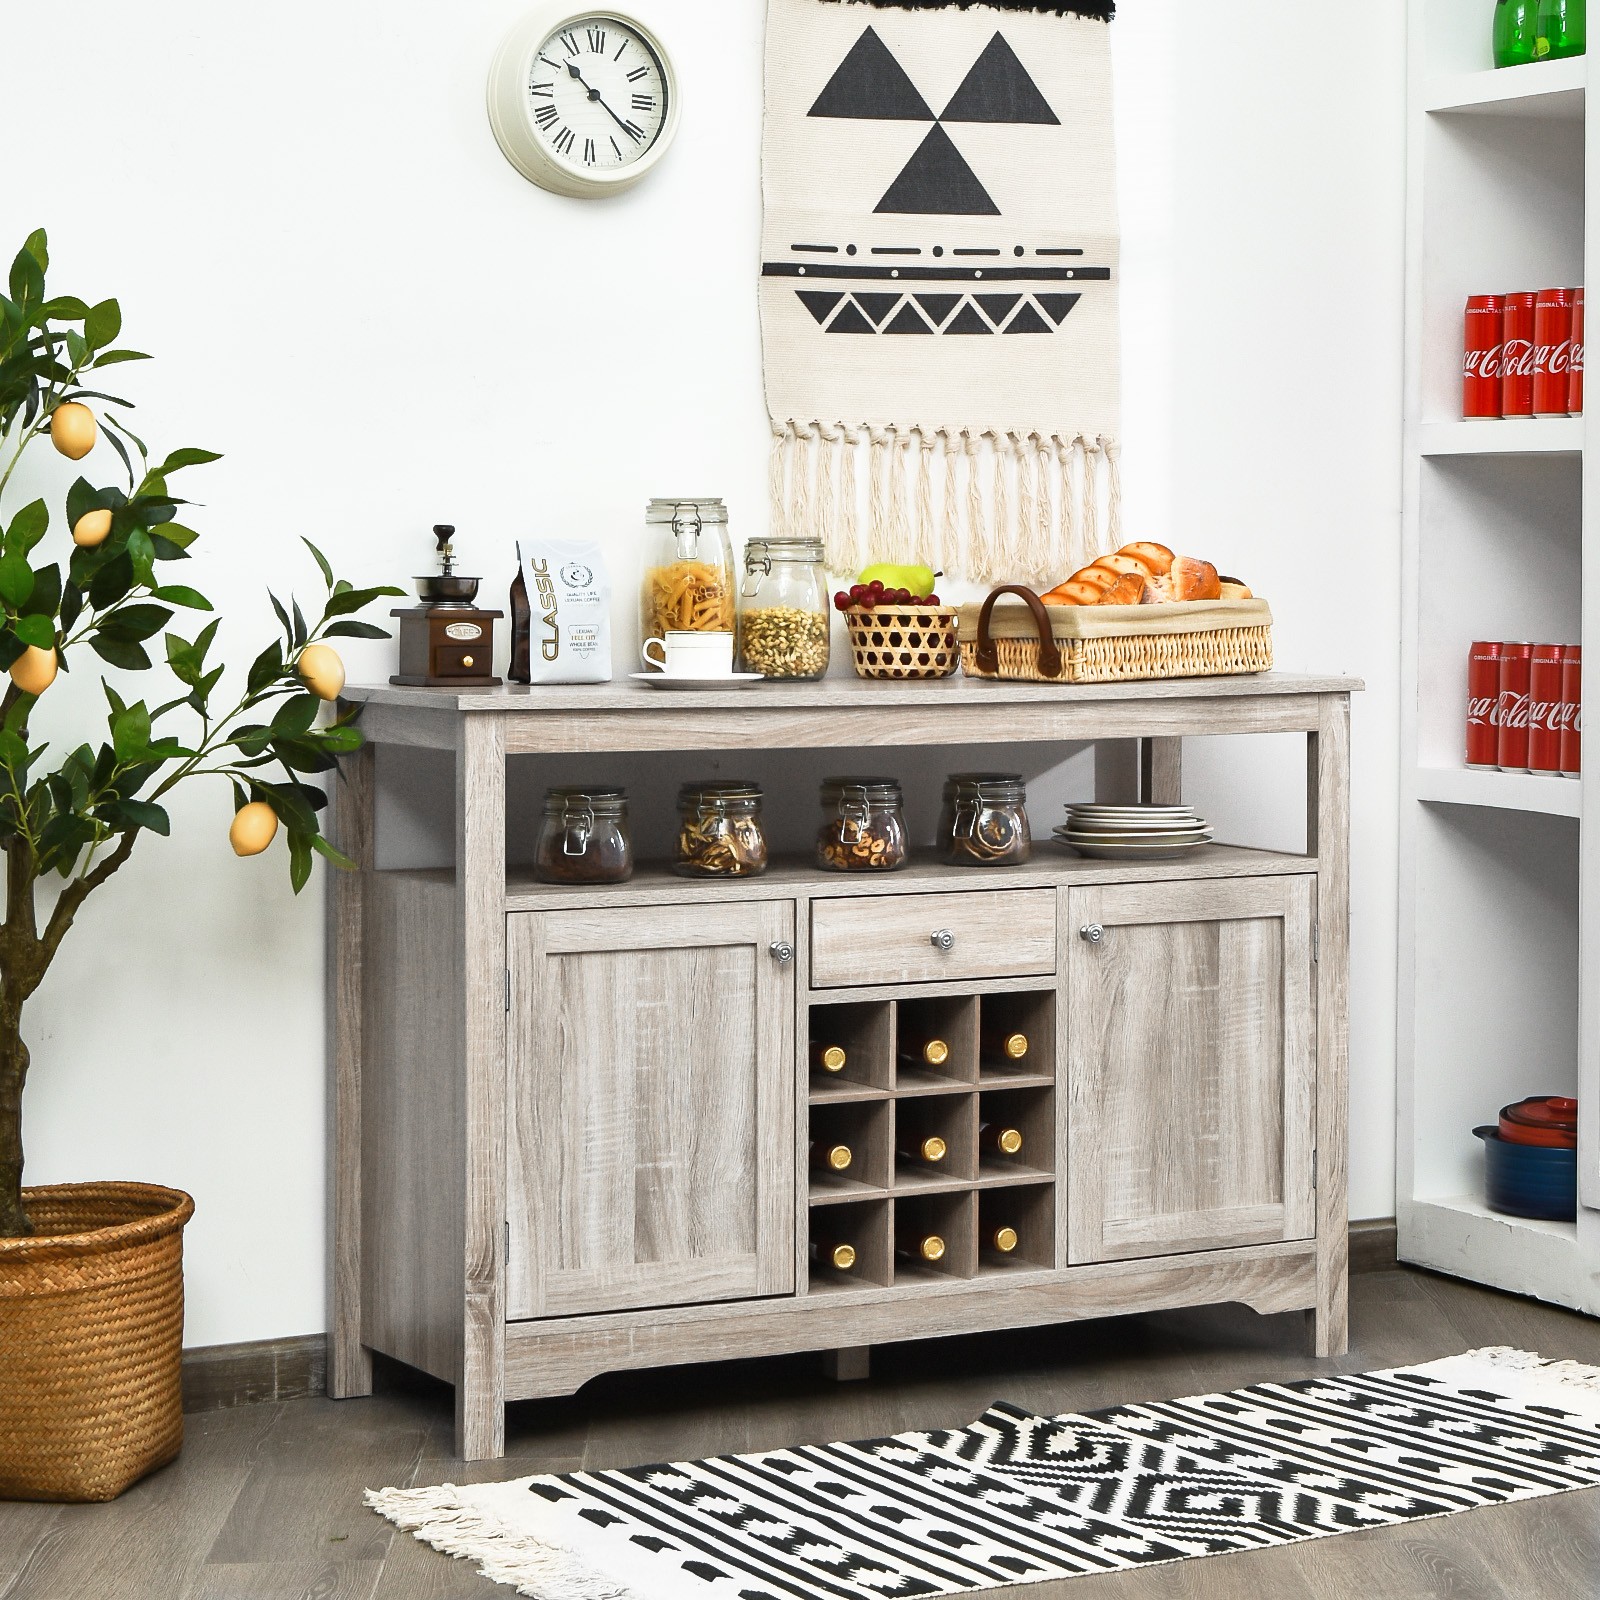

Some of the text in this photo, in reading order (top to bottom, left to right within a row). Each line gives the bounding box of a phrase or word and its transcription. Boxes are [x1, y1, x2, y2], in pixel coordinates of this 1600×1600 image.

[560, 32, 581, 58] XI
[586, 29, 606, 54] XII
[632, 94, 653, 111] III
[531, 557, 559, 661] CLASSIC
